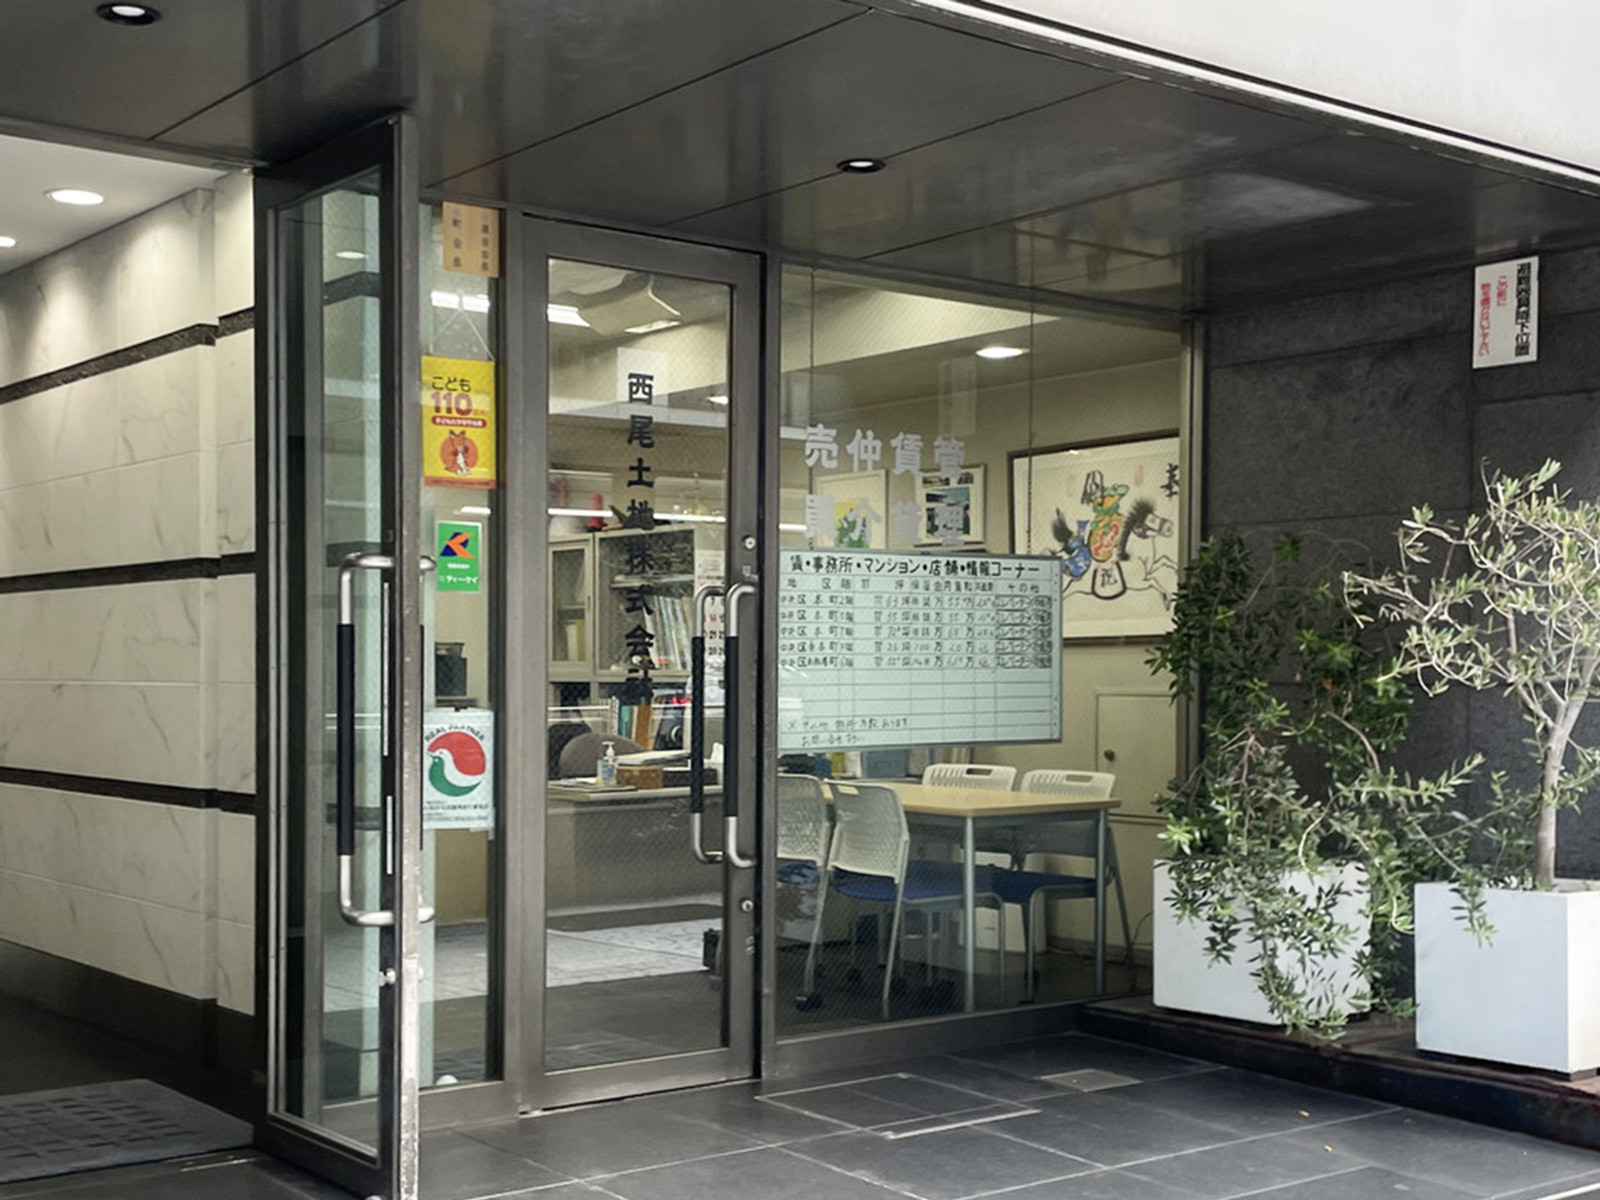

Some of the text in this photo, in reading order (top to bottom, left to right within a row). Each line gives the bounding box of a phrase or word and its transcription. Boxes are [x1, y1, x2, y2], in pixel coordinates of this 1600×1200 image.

[432, 376, 471, 392] こども
[431, 392, 472, 416] 110
